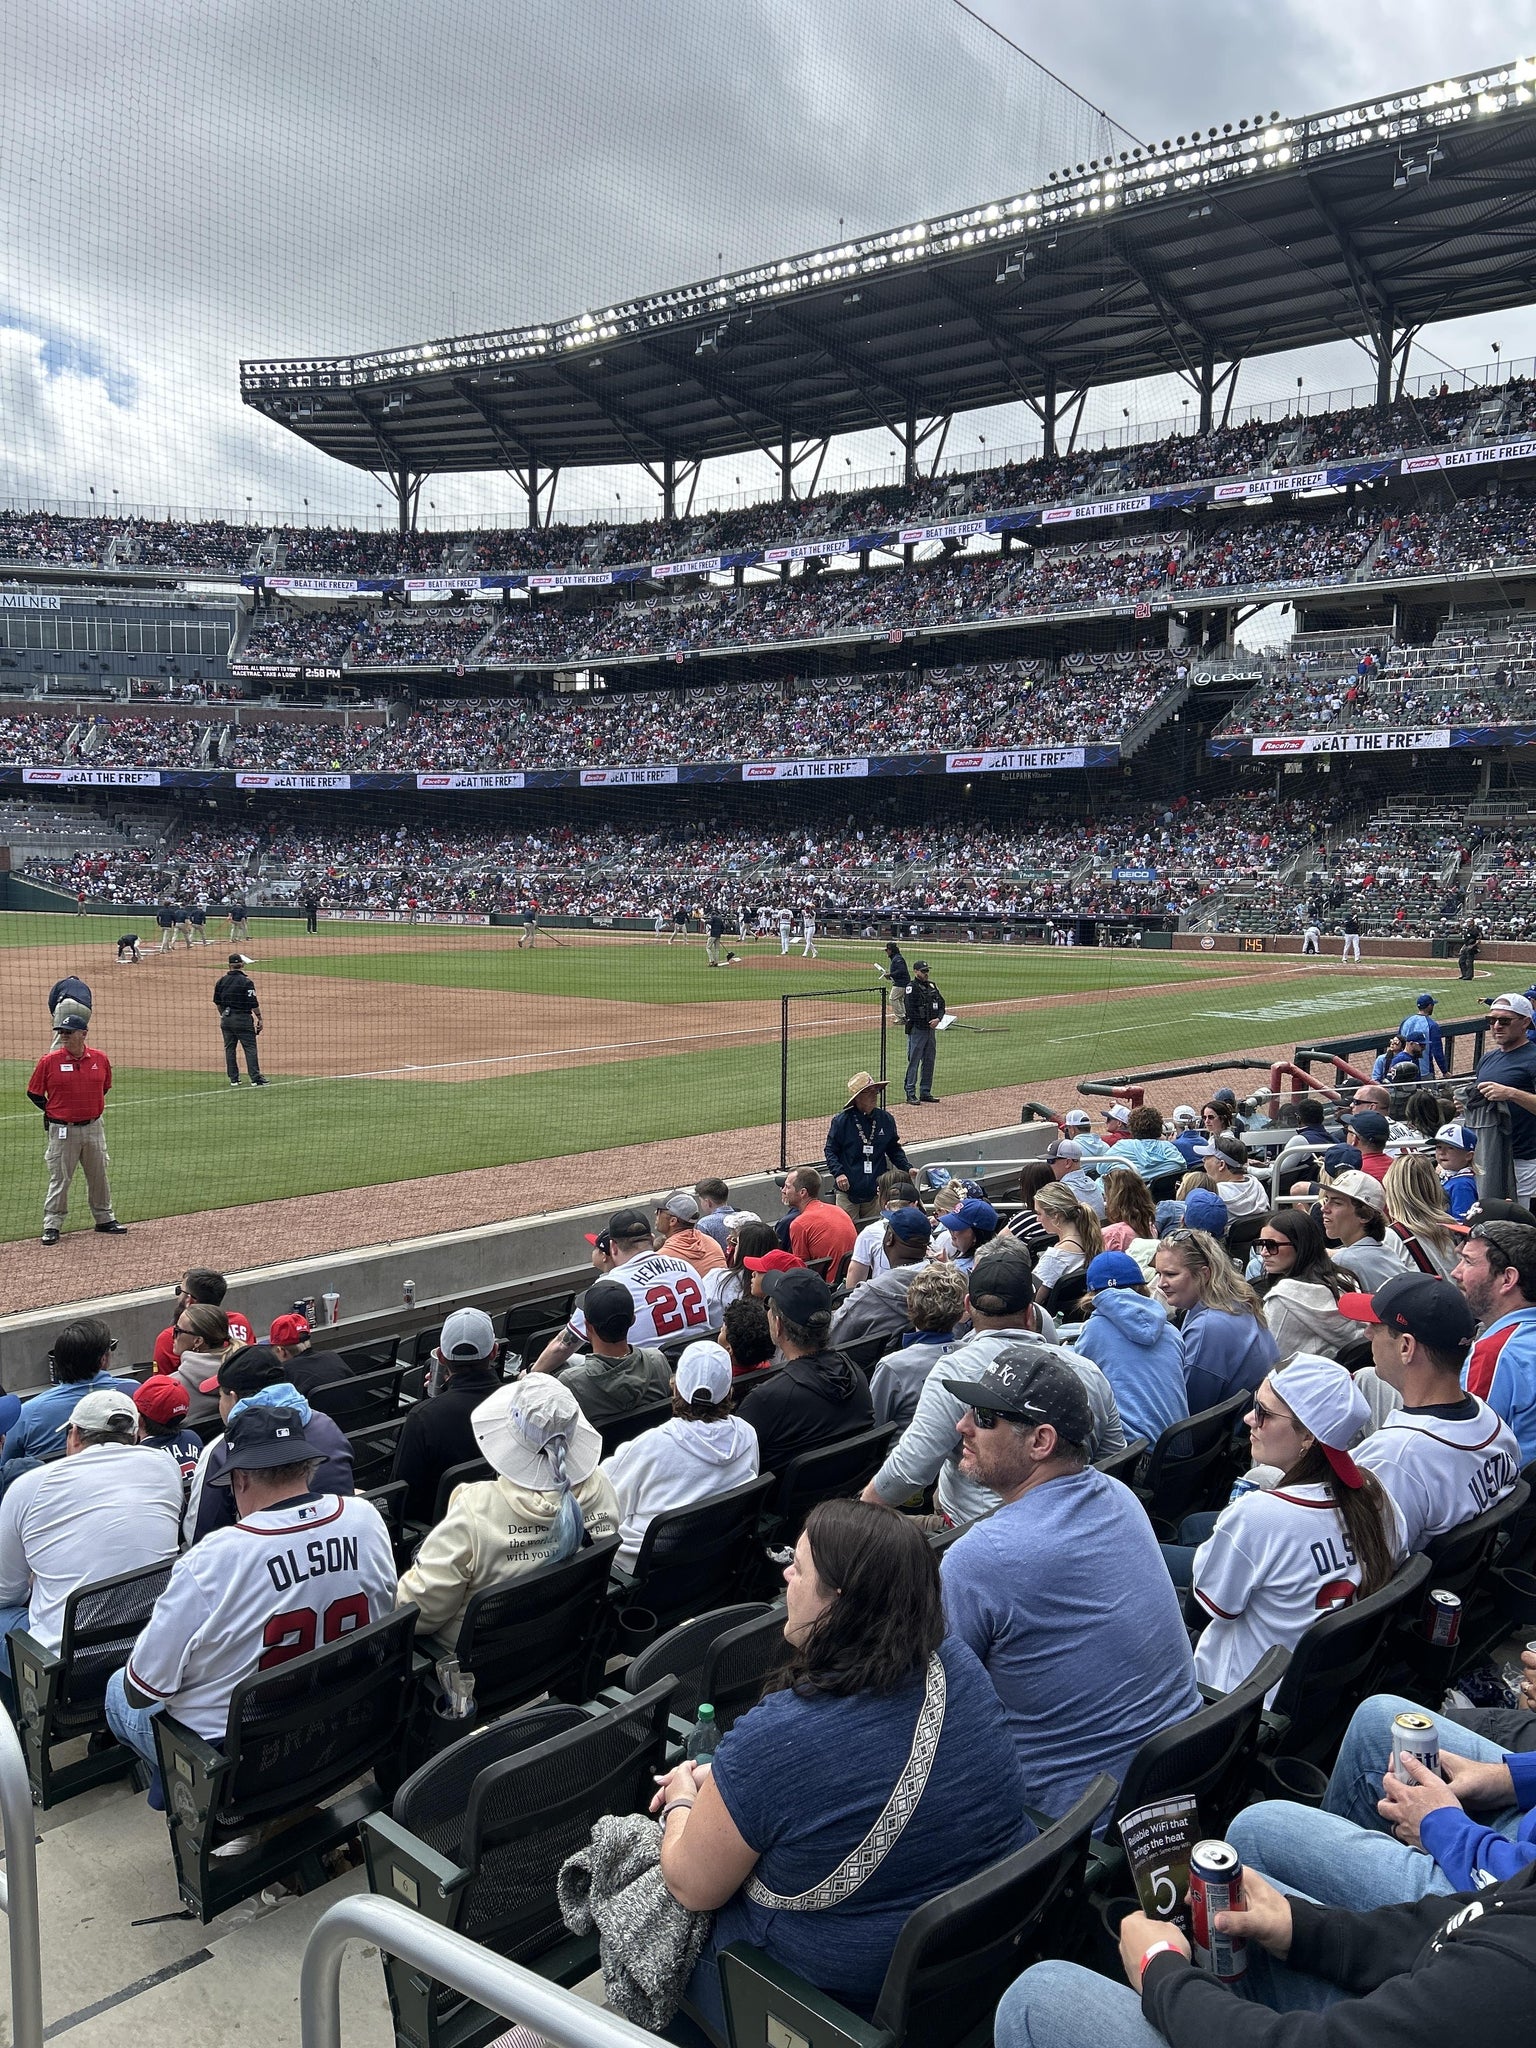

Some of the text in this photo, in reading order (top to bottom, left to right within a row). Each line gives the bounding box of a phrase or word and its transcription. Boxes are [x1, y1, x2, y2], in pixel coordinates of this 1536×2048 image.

[1446, 453, 1472, 465] BEAT
[1476, 450, 1495, 461] THE
[1250, 482, 1269, 493] BEAT
[1273, 479, 1289, 489] THE
[1076, 507, 1095, 516] BEAT
[1099, 504, 1113, 513] THE
[926, 528, 942, 538] BEAT
[945, 526, 956, 535] THE
[791, 548, 806, 556] BEAT
[809, 546, 821, 554] THE
[673, 565, 686, 573] BEAT
[688, 563, 698, 571] THE
[2, 595, 57, 609] MILNER
[1135, 602, 1151, 619] 21
[889, 628, 903, 643] 10
[676, 650, 683, 663] 6
[305, 668, 340, 678] 2:58 PM
[456, 664, 464, 676] 3
[1212, 672, 1262, 682] LEXUS
[1264, 741, 1303, 750] RaceTrac
[1354, 735, 1382, 749] THE
[1018, 754, 1037, 767] THE
[1040, 752, 1072, 765] FREE
[631, 771, 644, 782] THE
[647, 770, 669, 781] FREE
[808, 763, 825, 776] THE
[828, 762, 857, 774] FREE
[97, 773, 115, 782] THE
[119, 773, 149, 783] FREE
[300, 777, 315, 786] THE
[318, 777, 342, 786] FREE
[480, 777, 493, 786] THE
[495, 776, 517, 786] FREE
[631, 1258, 688, 1286] HEYWARD
[645, 1277, 707, 1336] 22
[998, 1364, 1016, 1386] KC
[1468, 1452, 1519, 1519] JUSTIC
[508, 1524, 532, 1534] Dear
[510, 1539, 525, 1548] the
[528, 1536, 553, 1545] world
[506, 1551, 529, 1561] with
[532, 1550, 550, 1561] you
[1310, 1532, 1356, 1576] OLS
[266, 1536, 358, 1592] OLSON
[1128, 1818, 1189, 1846] Reliable WiFi that
[1133, 1832, 1185, 1859] brings the heat
[402, 1880, 408, 1892] 6
[1150, 1865, 1177, 1915] 5
[784, 2033, 792, 2048] 7
